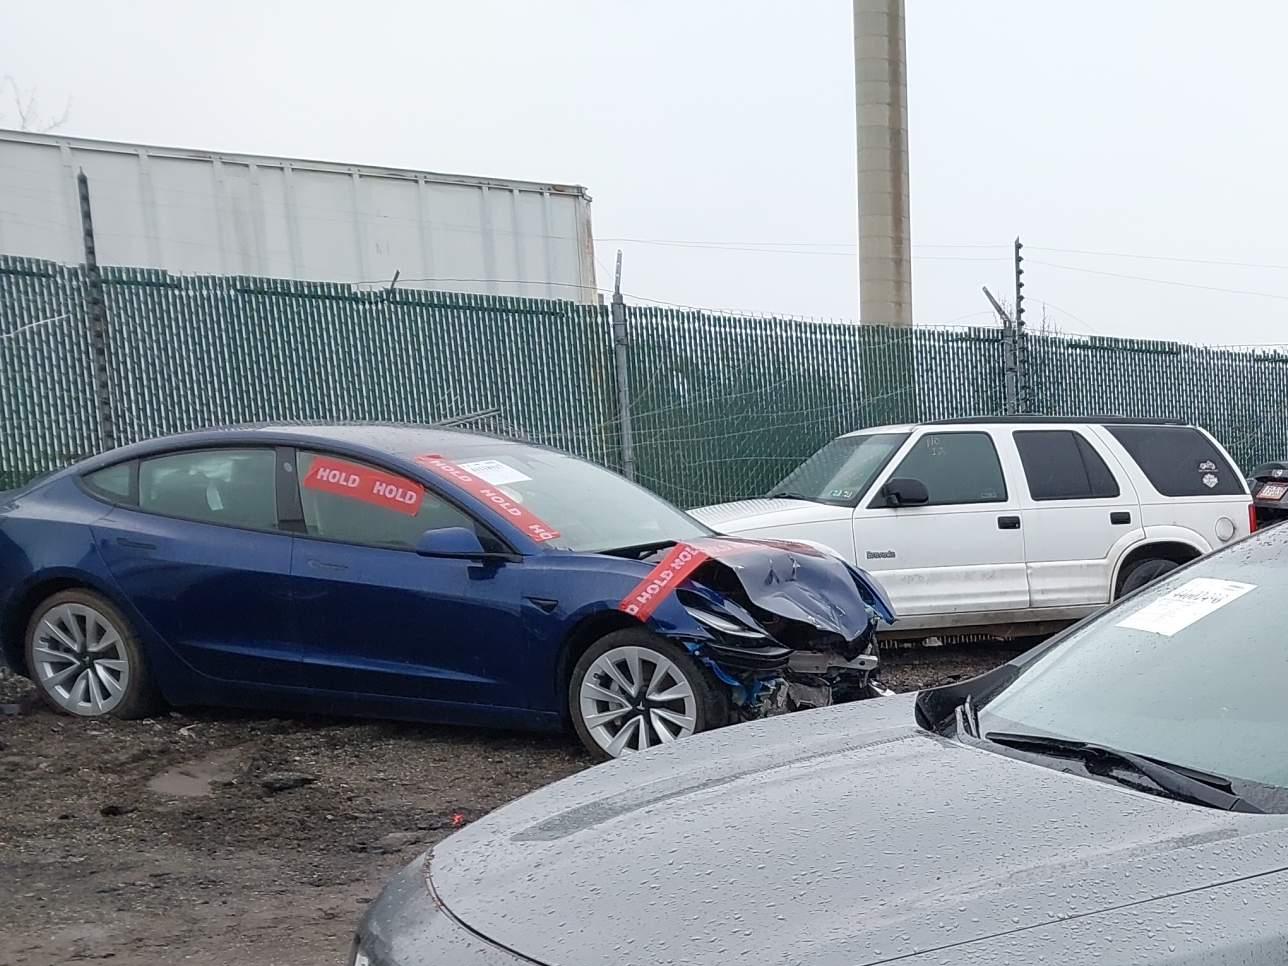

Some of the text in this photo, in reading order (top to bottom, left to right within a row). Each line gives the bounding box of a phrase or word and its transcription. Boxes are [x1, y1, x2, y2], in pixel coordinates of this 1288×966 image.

[316, 467, 417, 504] HOLD HOLD
[429, 460, 473, 482] HOLD
[480, 488, 522, 516] HOLD
[637, 571, 674, 604] HOLD
